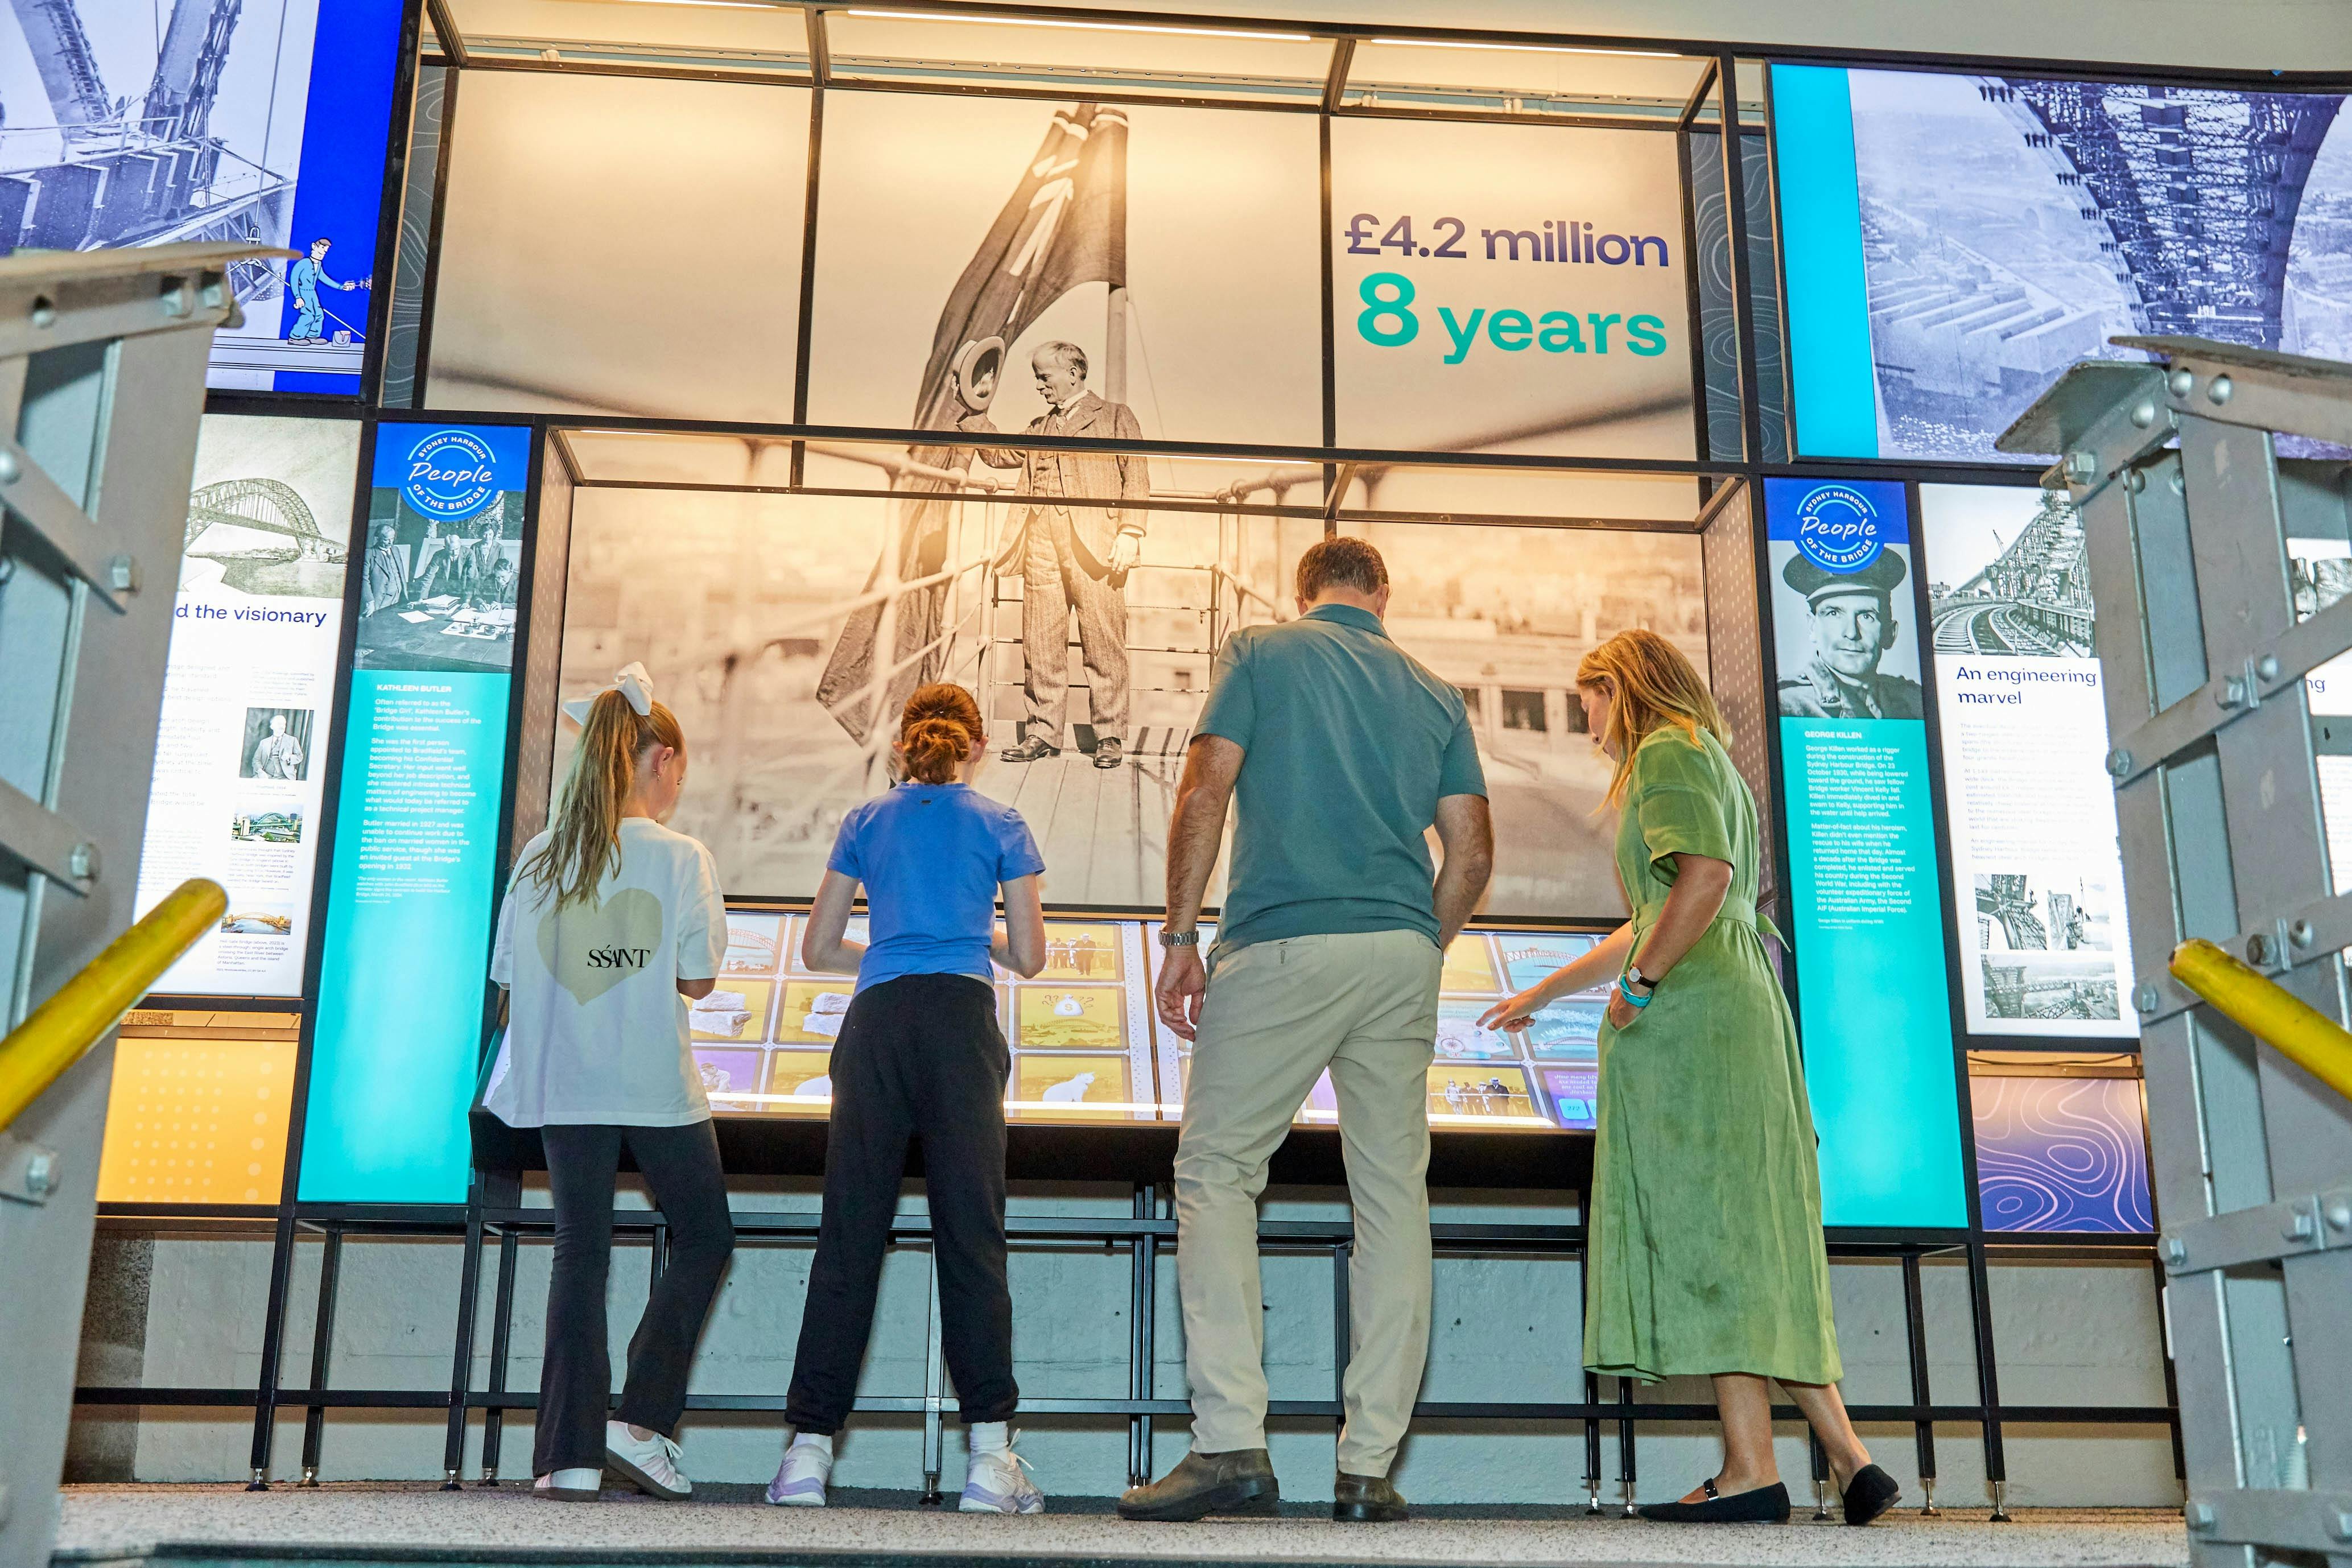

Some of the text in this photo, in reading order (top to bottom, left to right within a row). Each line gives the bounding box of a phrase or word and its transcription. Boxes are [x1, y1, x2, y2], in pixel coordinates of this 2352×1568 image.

[1344, 213, 1669, 267] £4.2 million
[1357, 271, 1666, 365] 8 years
[418, 437, 486, 459] SYDNEY HARBOUR
[408, 462, 492, 487] People
[413, 484, 485, 509] OF THE BRIDGE
[1806, 492, 1868, 514] SYDNEY HARBOUR
[1801, 516, 1876, 540] People
[1807, 538, 1872, 563] OF THE BRIDGE
[195, 605, 228, 619] the
[234, 606, 327, 627] visionary
[1957, 667, 2096, 686] An engineering
[1958, 691, 2021, 704] marvel
